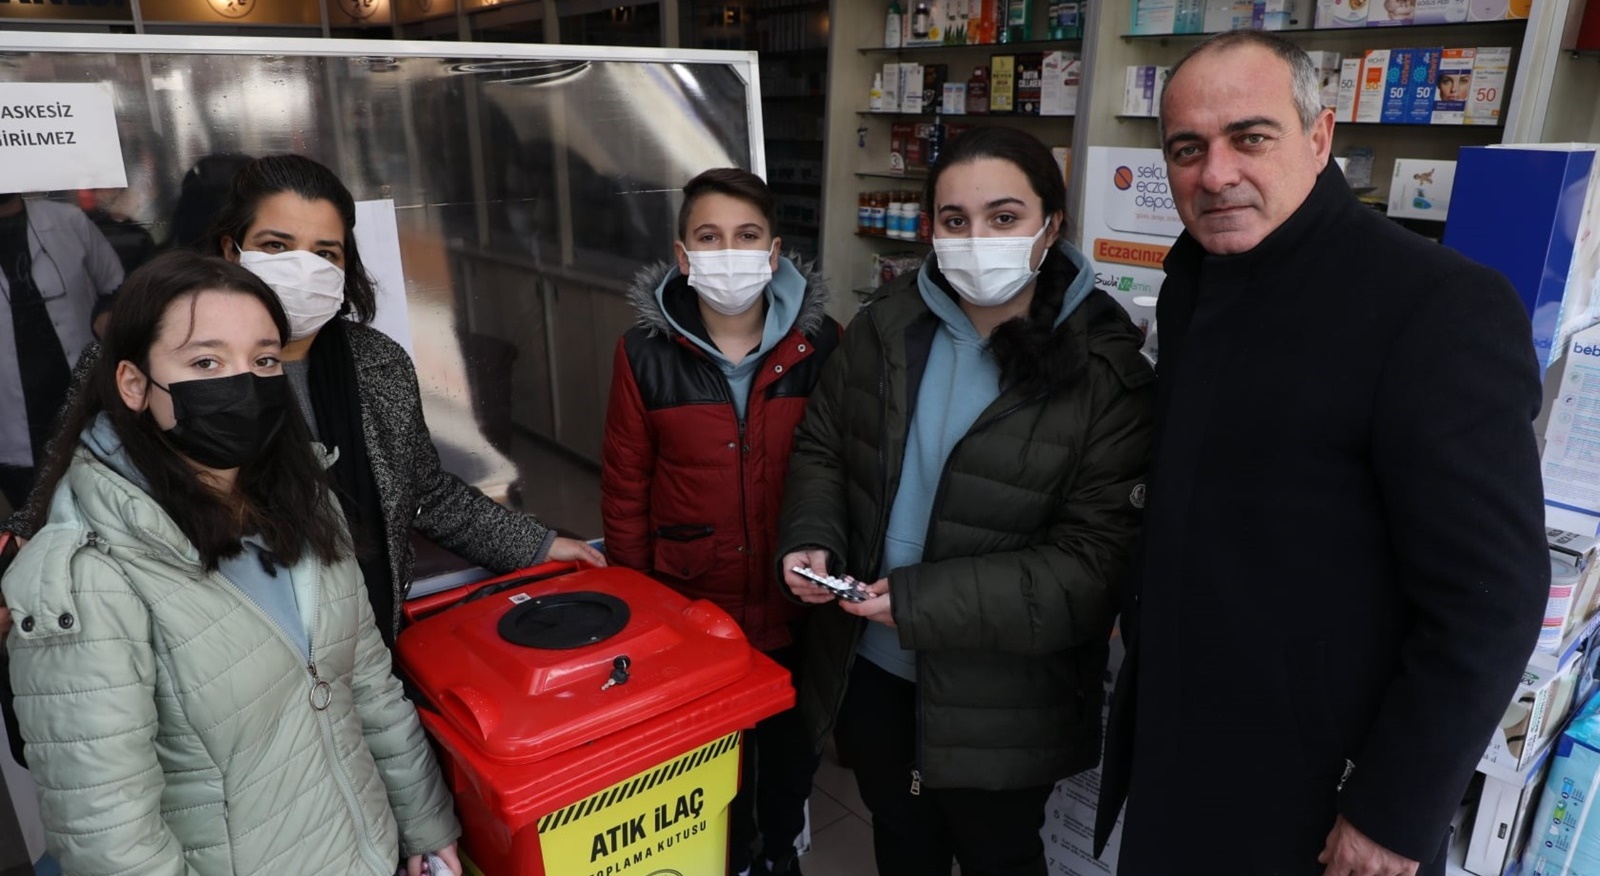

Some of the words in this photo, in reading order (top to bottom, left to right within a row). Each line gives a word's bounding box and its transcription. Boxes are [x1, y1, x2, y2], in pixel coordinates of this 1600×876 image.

[1136, 181, 1167, 194] ecza
[1100, 242, 1165, 263] Eczacınız
[590, 813, 647, 863] ATIK
[657, 820, 707, 852] KUTUSU
